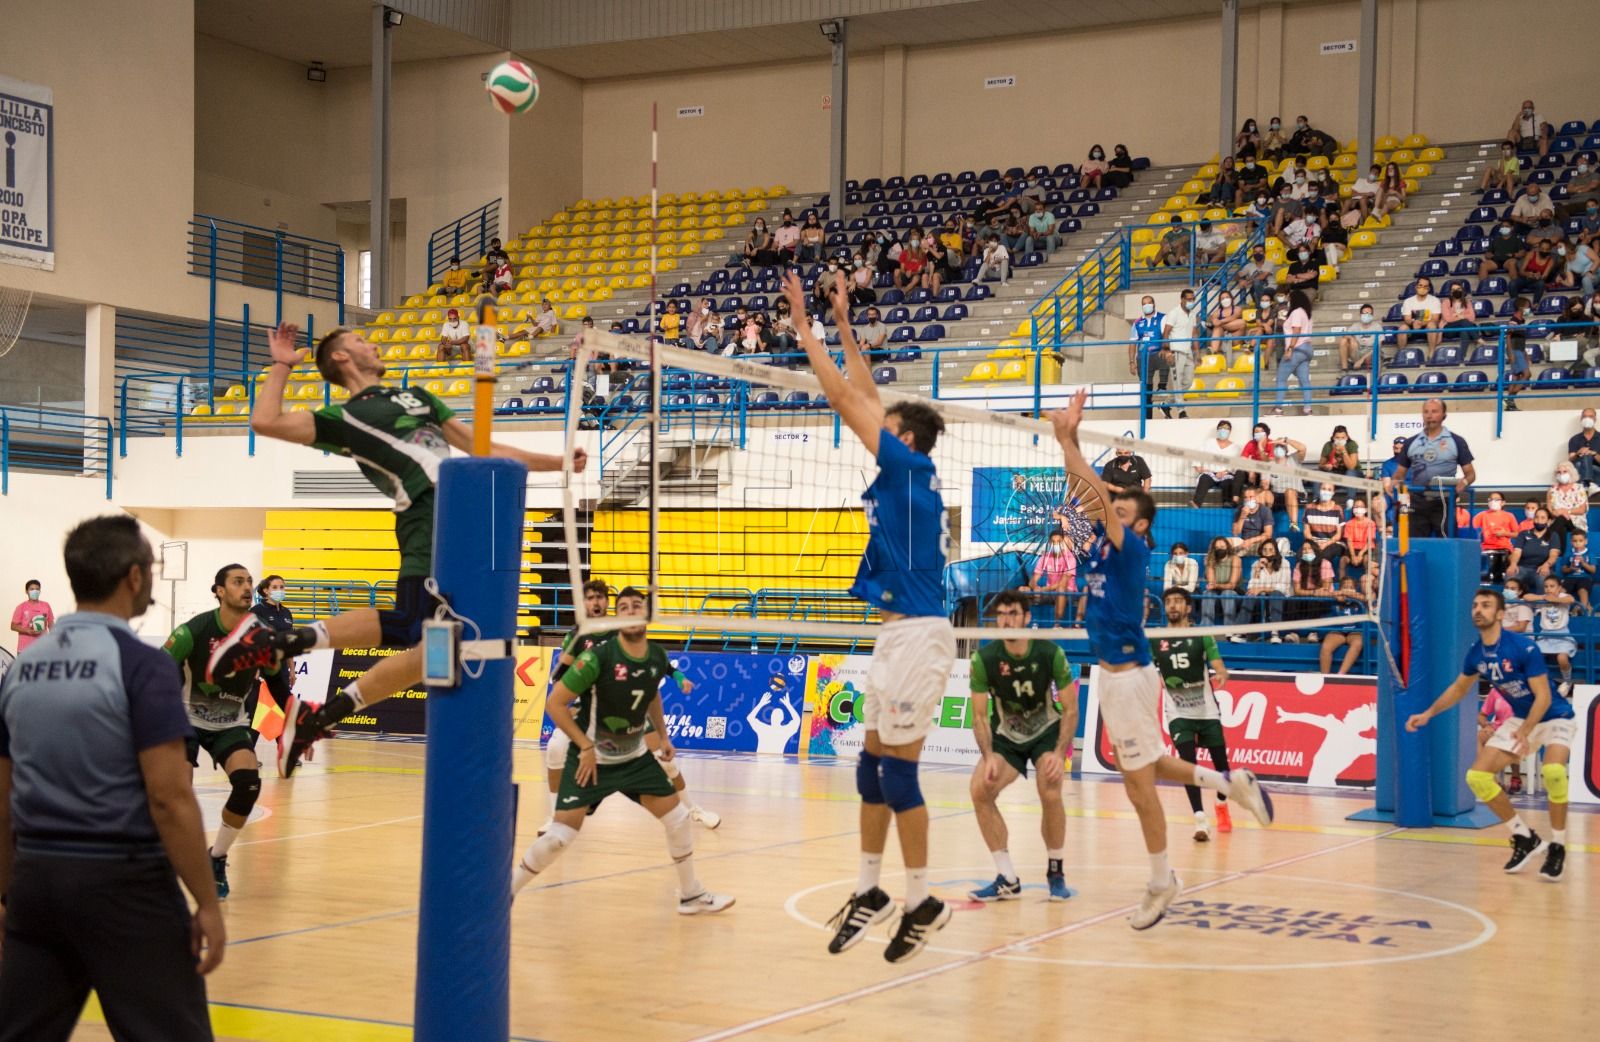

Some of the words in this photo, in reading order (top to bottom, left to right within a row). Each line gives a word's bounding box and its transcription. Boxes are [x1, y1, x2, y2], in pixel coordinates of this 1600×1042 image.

[802, 434, 809, 443] 2
[1169, 652, 1190, 670] 15
[19, 660, 97, 682] RFEVB
[1012, 680, 1035, 697] 14
[631, 689, 645, 711] 7
[677, 714, 692, 726] AL
[681, 725, 704, 738] 690
[1232, 748, 1304, 767] MASCULINA
[1160, 917, 1400, 948] APITAL
